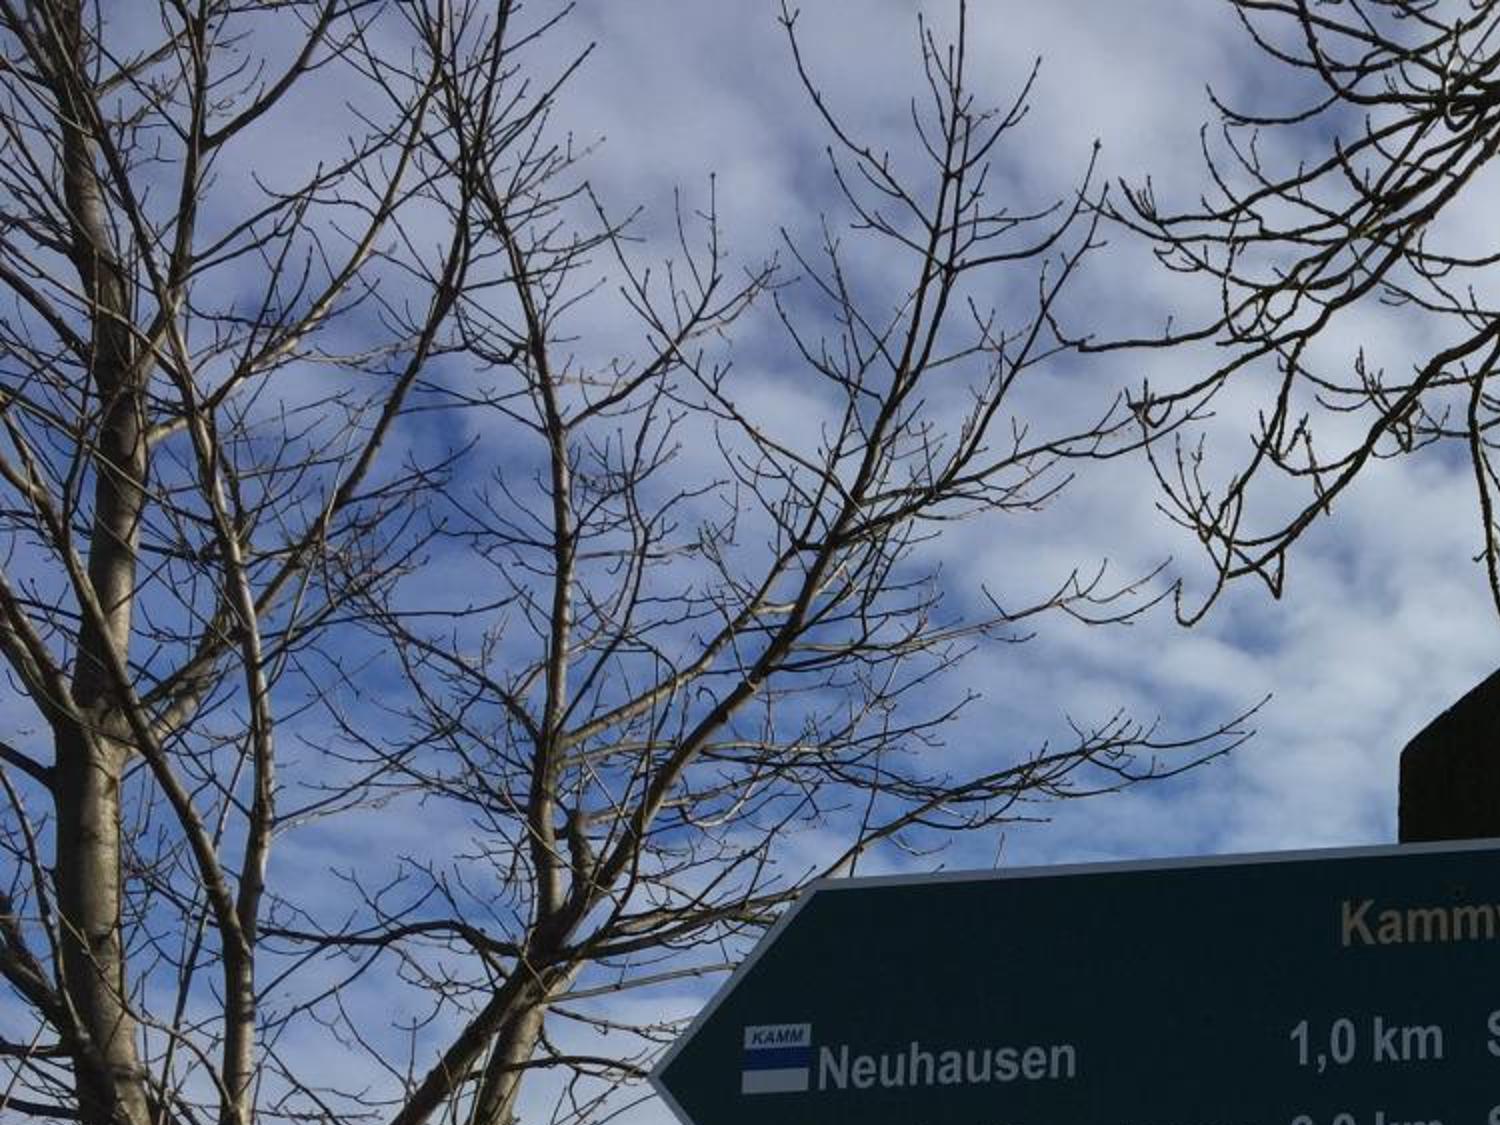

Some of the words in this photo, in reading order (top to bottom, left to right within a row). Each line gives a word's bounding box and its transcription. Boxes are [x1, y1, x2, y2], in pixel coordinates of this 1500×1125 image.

[752, 1028, 804, 1044] KAMM
[1290, 1018, 1357, 1074] 1,0
[1374, 1017, 1444, 1062] km
[818, 1042, 1076, 1090] Neuhausen
